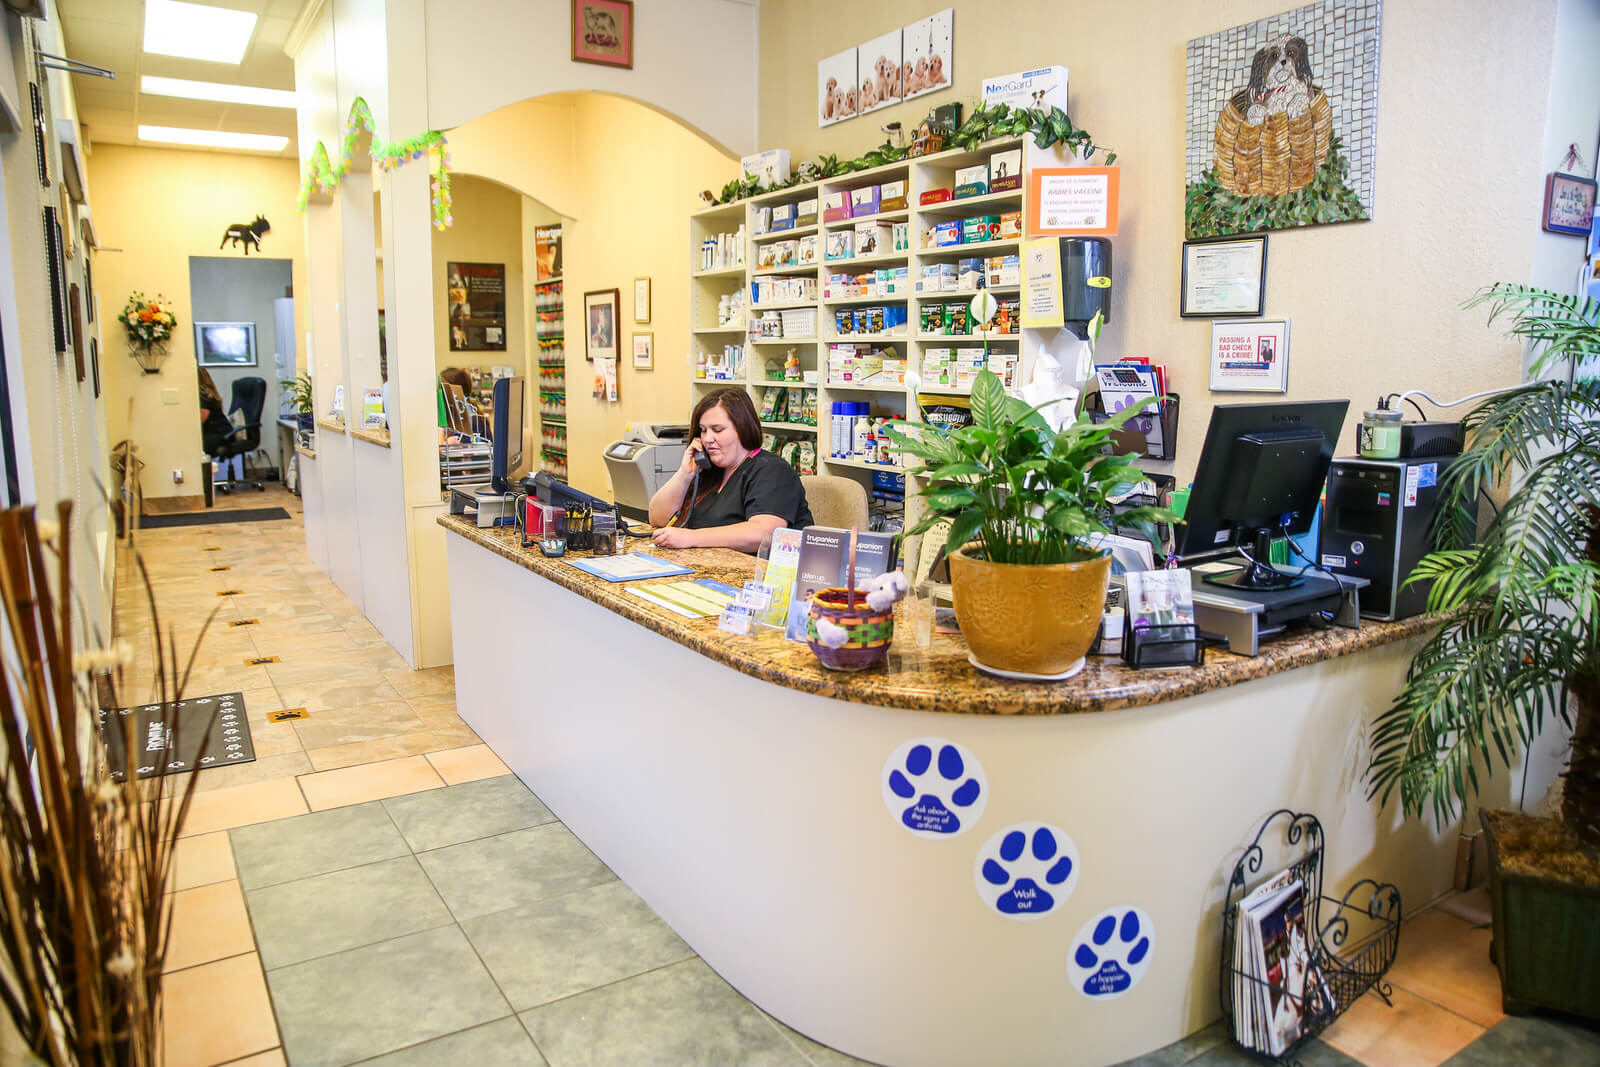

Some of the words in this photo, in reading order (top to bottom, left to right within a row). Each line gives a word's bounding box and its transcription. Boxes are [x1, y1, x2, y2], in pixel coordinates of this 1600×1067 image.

[1073, 187, 1102, 195] VACCINE
[806, 534, 839, 545] trupanion
[927, 806, 948, 815] about
[911, 812, 922, 820] the
[923, 815, 940, 824] signs
[941, 815, 950, 824] of
[1013, 888, 1037, 898] Walk
[1017, 900, 1032, 909] out
